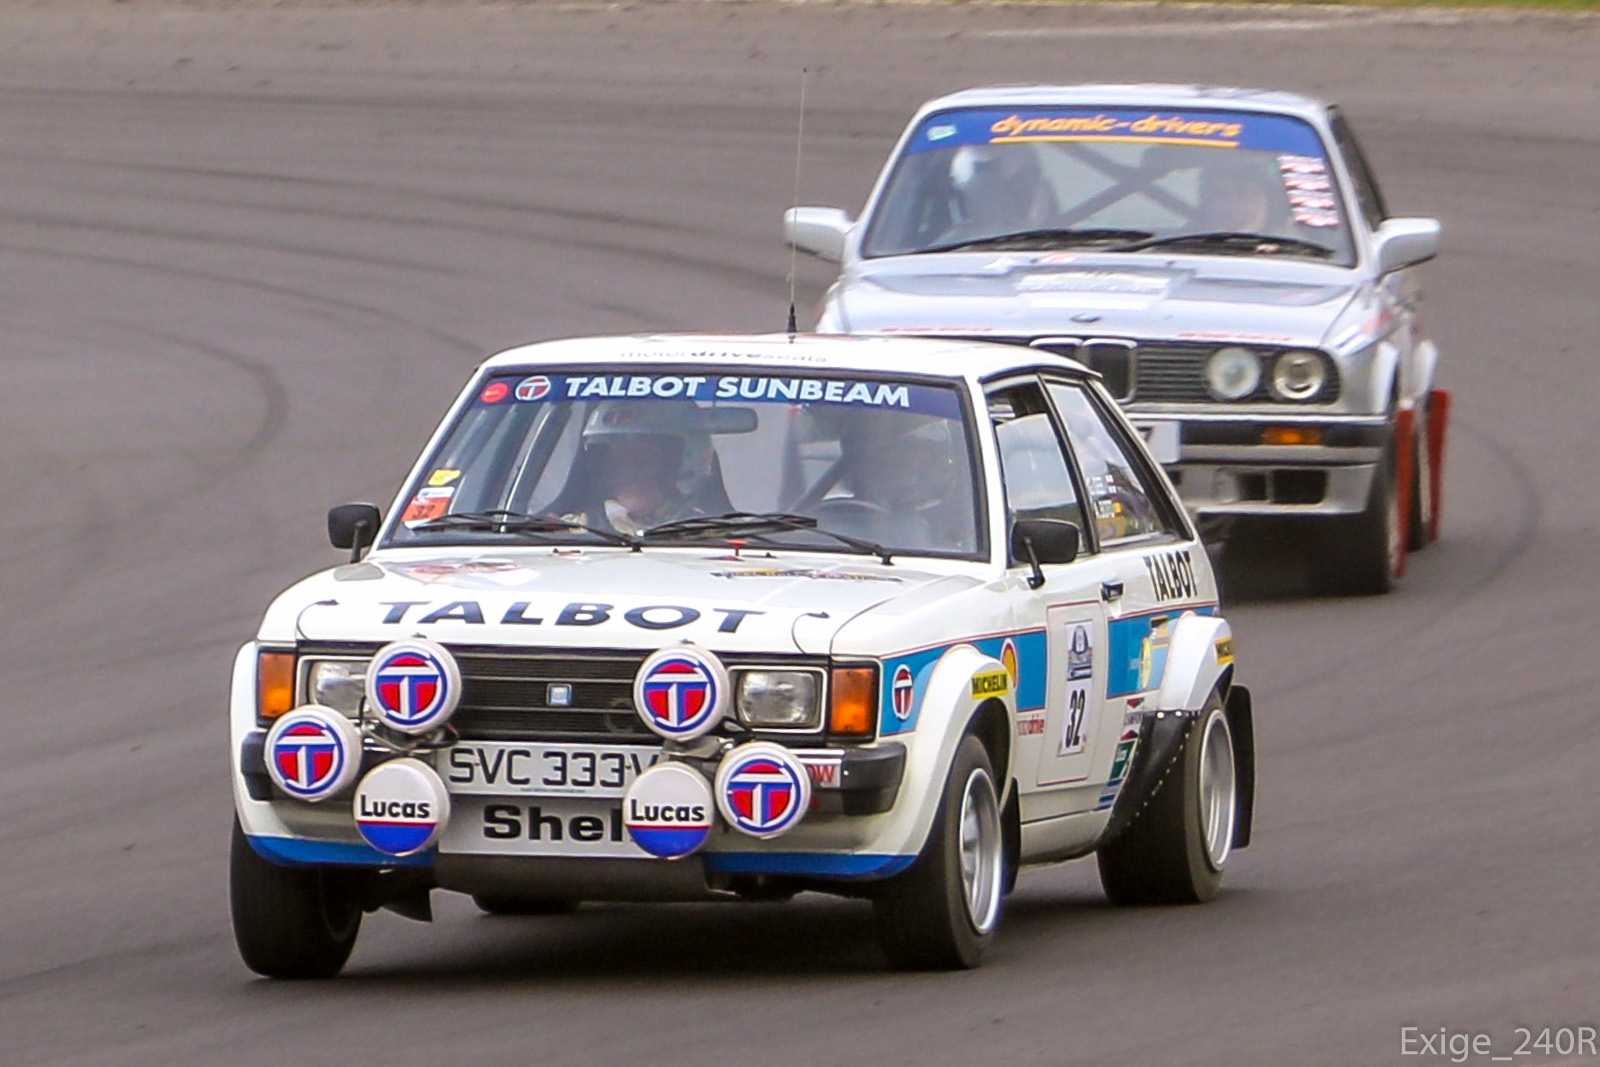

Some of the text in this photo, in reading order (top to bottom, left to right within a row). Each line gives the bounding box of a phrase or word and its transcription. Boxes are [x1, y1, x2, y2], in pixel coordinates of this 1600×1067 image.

[991, 115, 1242, 137] dynamic-drivers
[565, 376, 707, 398] TALBOT
[716, 376, 910, 408] SUNBEAM
[1143, 550, 1198, 602] TALBOT
[379, 600, 765, 633] TALBOT
[972, 673, 1008, 695] MICHELIN
[1065, 688, 1086, 749] 32
[449, 747, 532, 786] SVC
[360, 795, 430, 818] Lucas
[631, 799, 705, 822] Lucas
[483, 804, 630, 842] Shel
